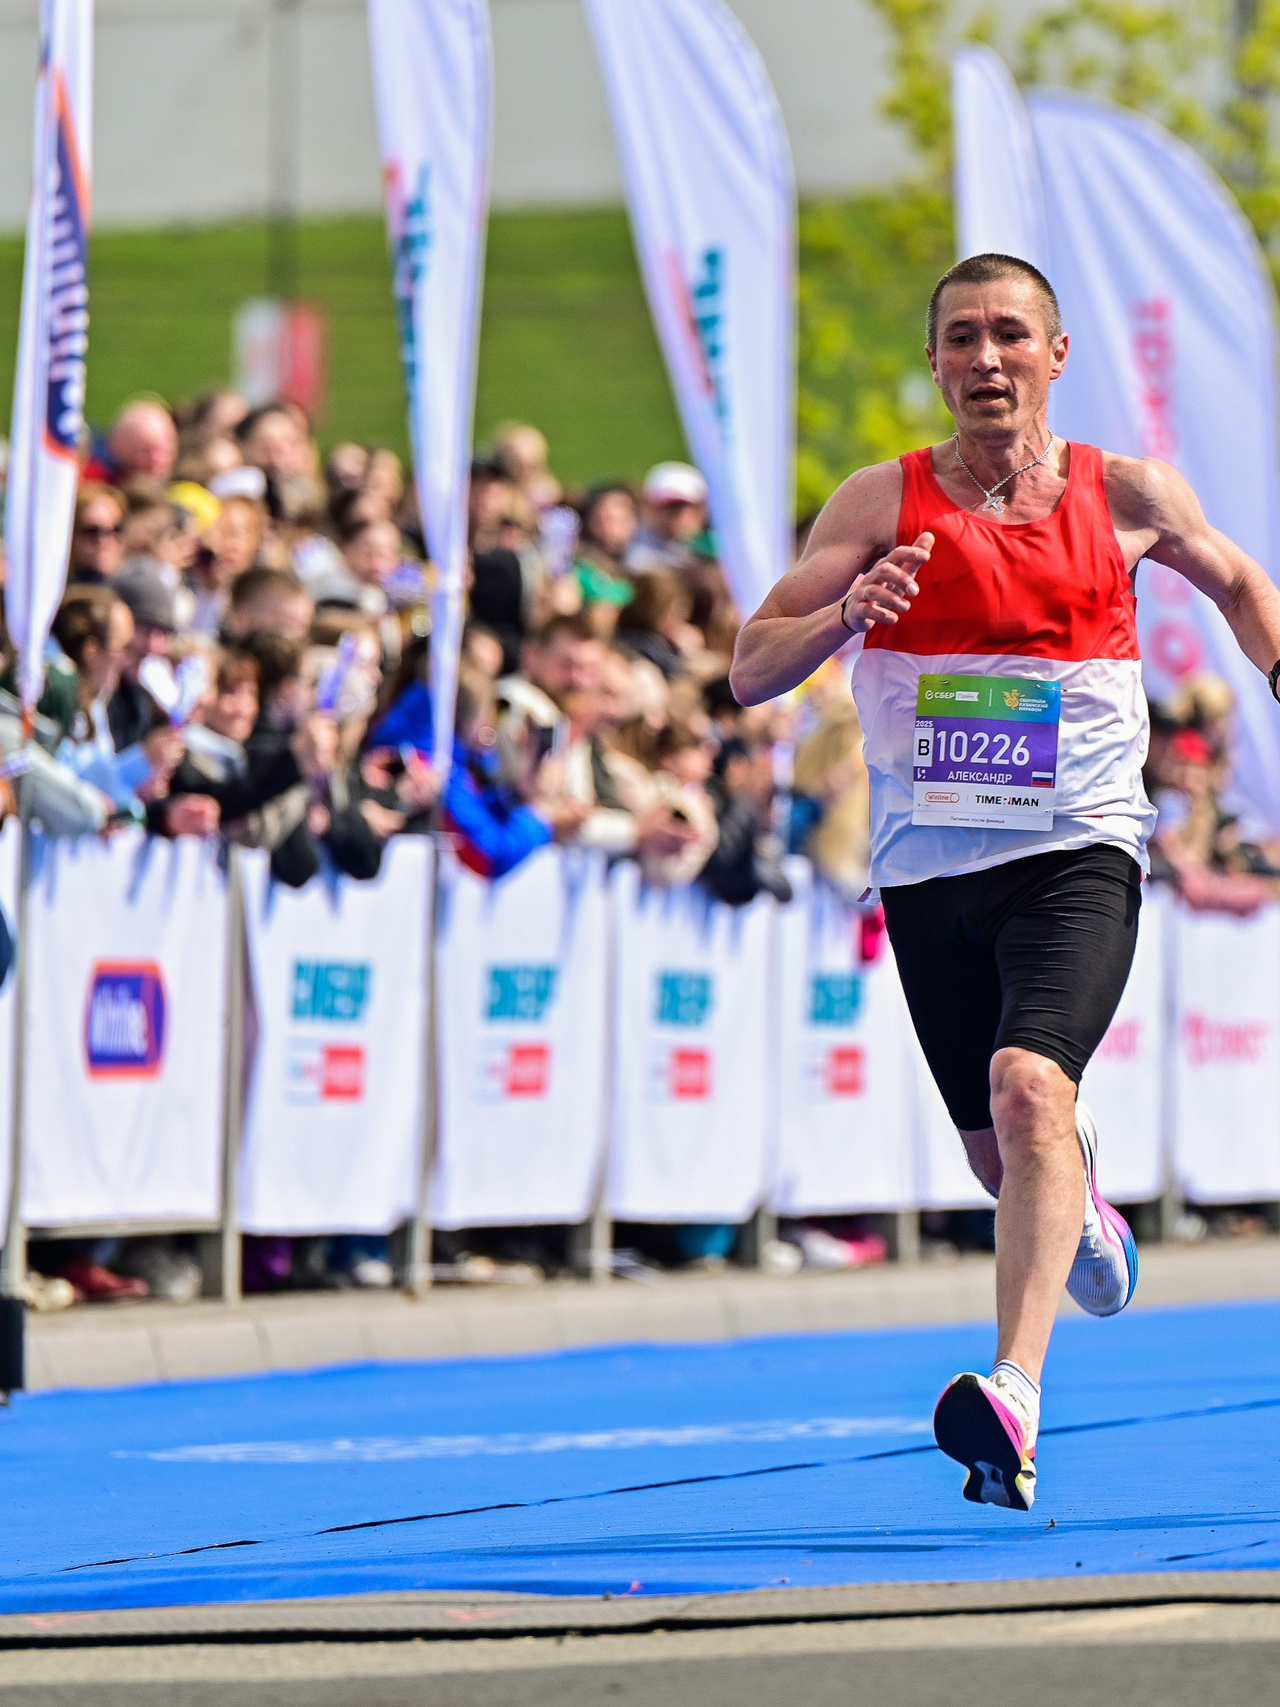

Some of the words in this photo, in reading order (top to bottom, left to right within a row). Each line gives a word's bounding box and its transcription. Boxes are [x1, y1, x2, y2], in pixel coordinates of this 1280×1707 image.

[934, 691, 955, 699] СБЕР
[915, 720, 933, 728] 2025
[936, 730, 1030, 766] 10226
[947, 770, 1013, 785] АЛЕКСАНДР
